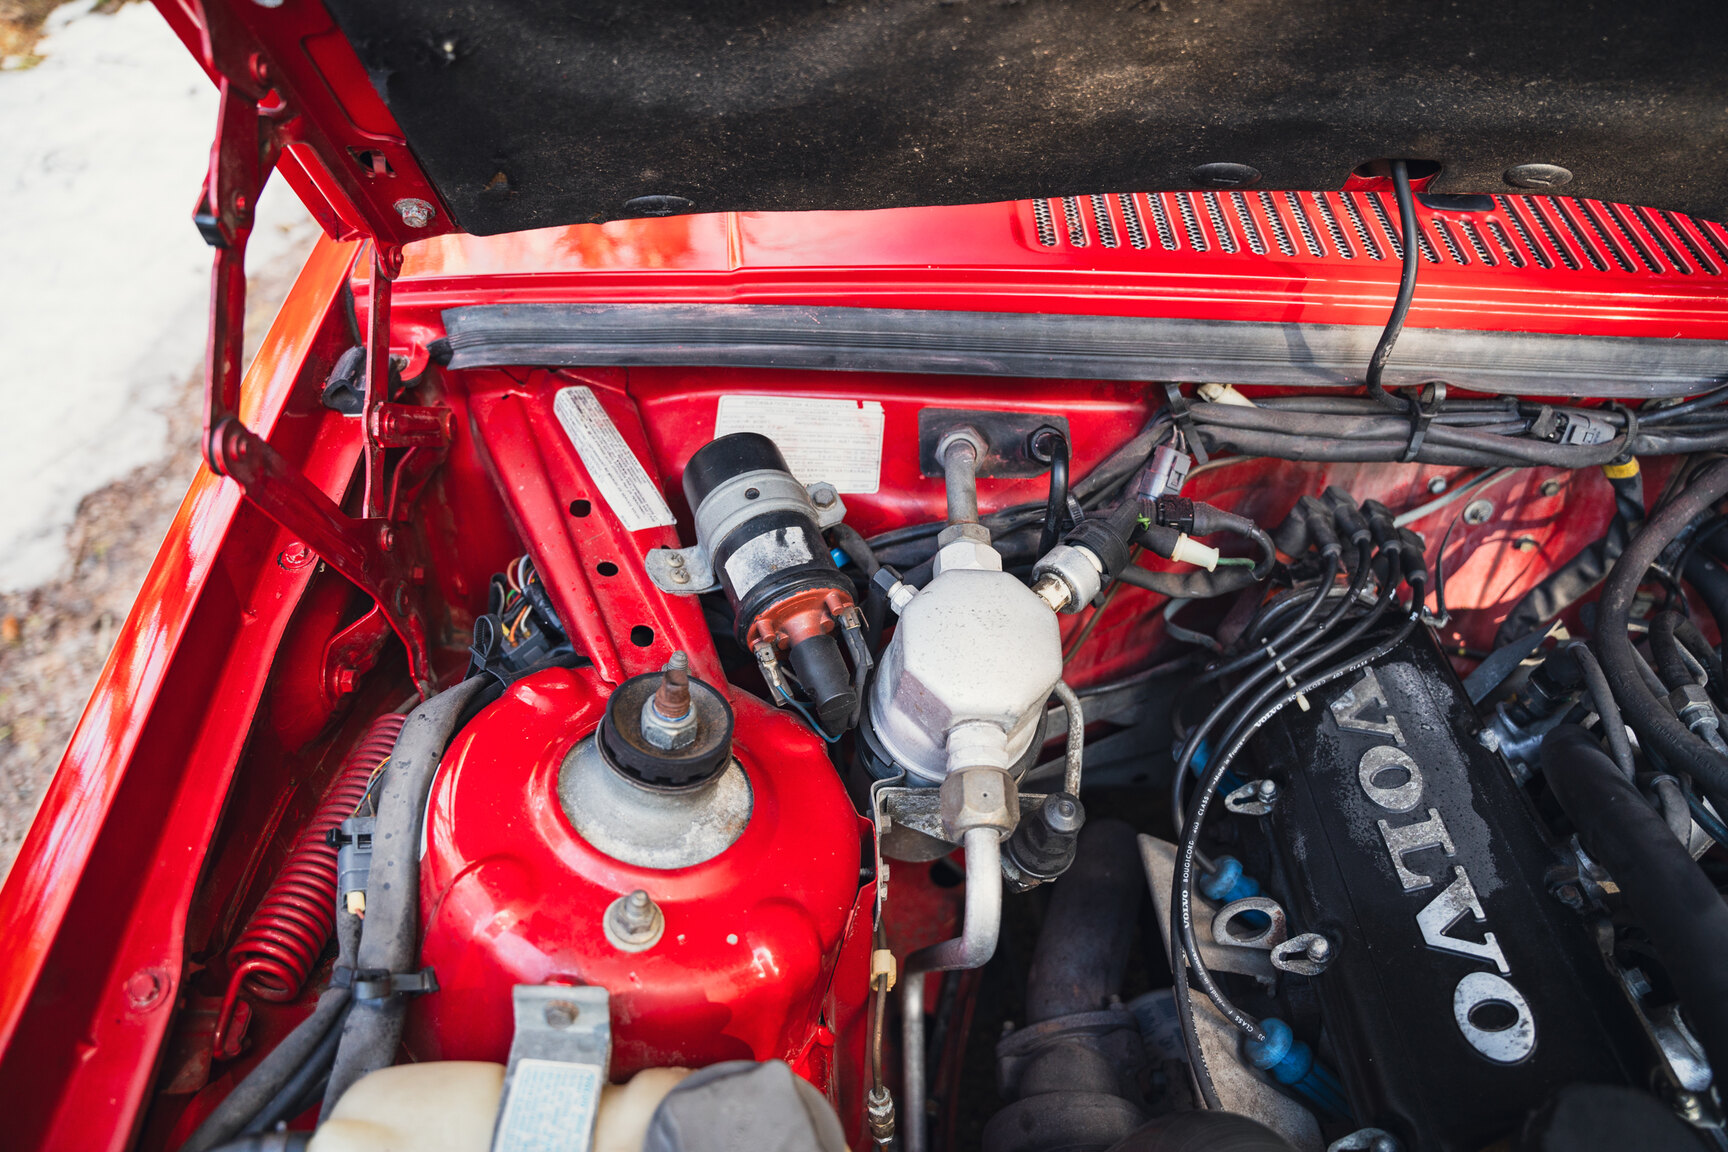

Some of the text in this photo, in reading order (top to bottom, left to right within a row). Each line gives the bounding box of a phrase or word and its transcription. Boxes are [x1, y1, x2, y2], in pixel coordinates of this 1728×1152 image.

[1349, 660, 1368, 672] CLASS
[1254, 703, 1283, 728] VOLVO
[1197, 796, 1209, 816] CLASS
[1182, 840, 1194, 883] BOUGICORD
[1330, 666, 1537, 1064] VOLVO
[1182, 889, 1190, 929] VOLVO
[1235, 1015, 1253, 1032] CLASS
